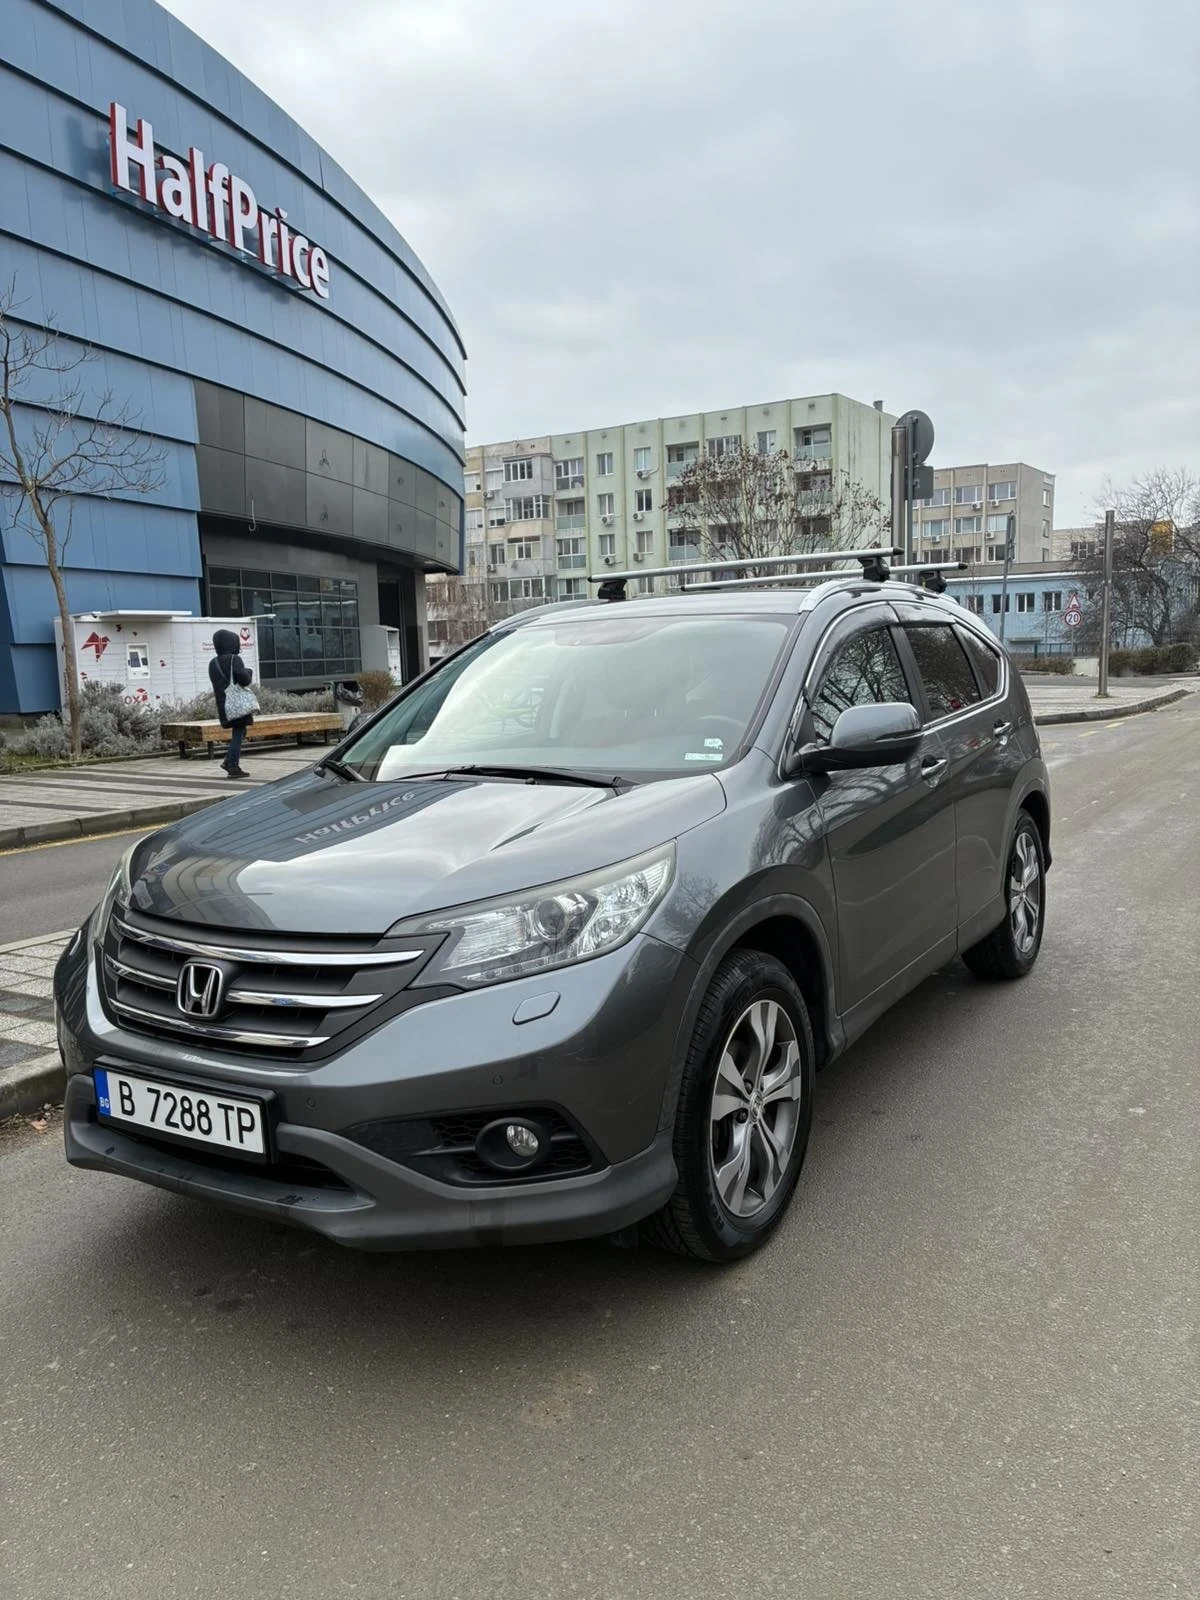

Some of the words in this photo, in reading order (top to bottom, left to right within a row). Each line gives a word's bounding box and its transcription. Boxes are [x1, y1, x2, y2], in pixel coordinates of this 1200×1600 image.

[109, 102, 330, 299] HalfPrice
[1068, 613, 1079, 624] 20
[99, 1096, 110, 1109] BG
[118, 1080, 135, 1116] B
[147, 1087, 212, 1136] 7288
[217, 1102, 256, 1144] TP
